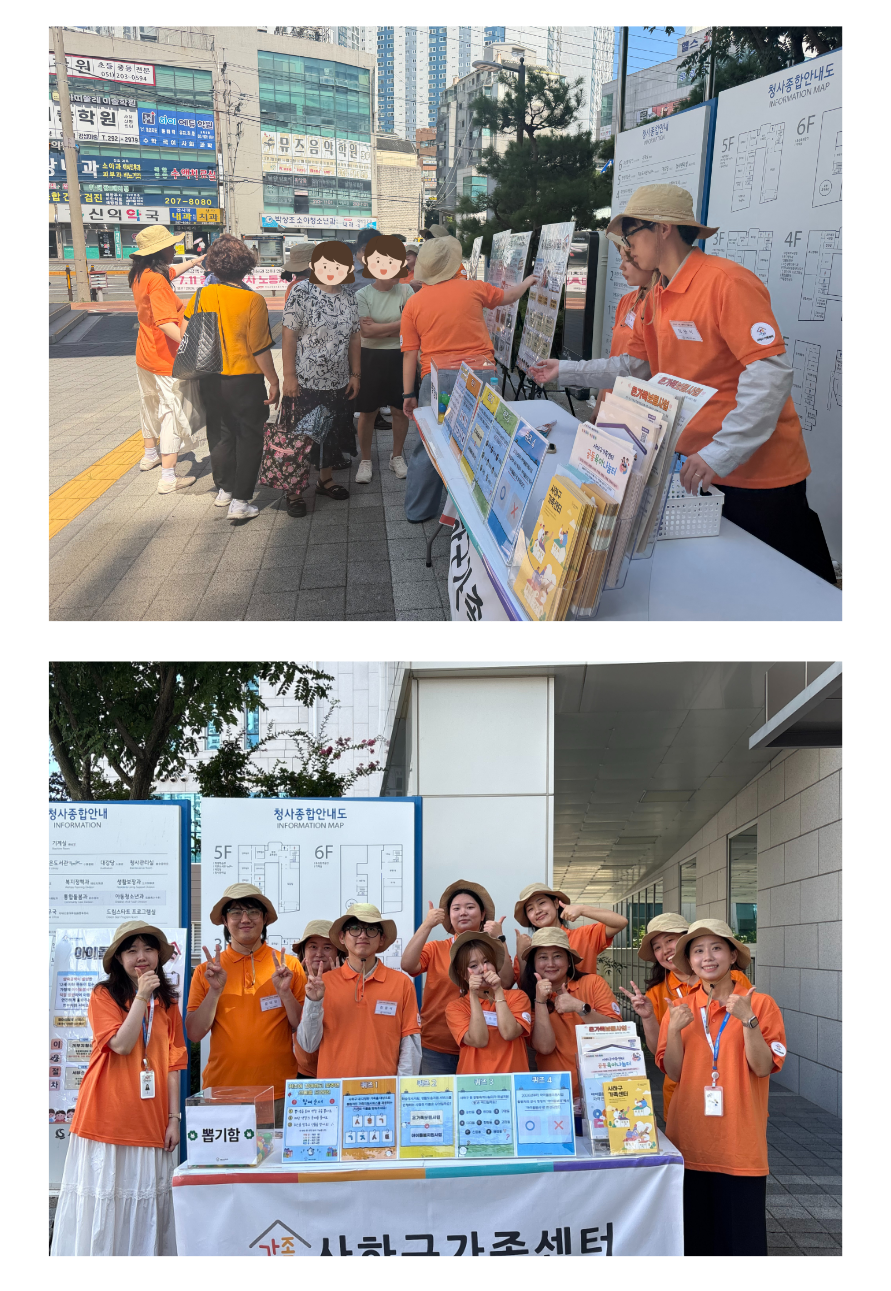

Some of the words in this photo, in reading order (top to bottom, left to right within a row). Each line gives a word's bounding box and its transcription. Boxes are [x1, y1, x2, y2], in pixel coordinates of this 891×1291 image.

[681, 39, 698, 53] 헬스
[98, 61, 114, 70] 초등
[135, 66, 151, 75] 전문
[768, 62, 835, 99] 청사종합안내도
[769, 88, 812, 108] INFORMATION
[812, 81, 831, 94] MAP
[159, 114, 177, 126] 하이
[797, 114, 816, 136] 6F
[721, 135, 736, 153] 5F
[102, 162, 121, 170] 소아과
[102, 171, 122, 179] 피부과
[170, 167, 216, 182] 수액치료실
[84, 193, 103, 203] 검진
[164, 197, 212, 206] 207-8080
[172, 212, 192, 221] 내과
[198, 213, 218, 222] 치과
[713, 231, 726, 246] 3F
[784, 231, 803, 248] 4F
[179, 275, 197, 285] 7.11
[48, 807, 108, 821] 청사종합안내
[274, 808, 348, 821] 청사종합안내도
[213, 845, 233, 860] 5F
[314, 844, 334, 860] 6F
[202, 1128, 240, 1143] 뽑기함
